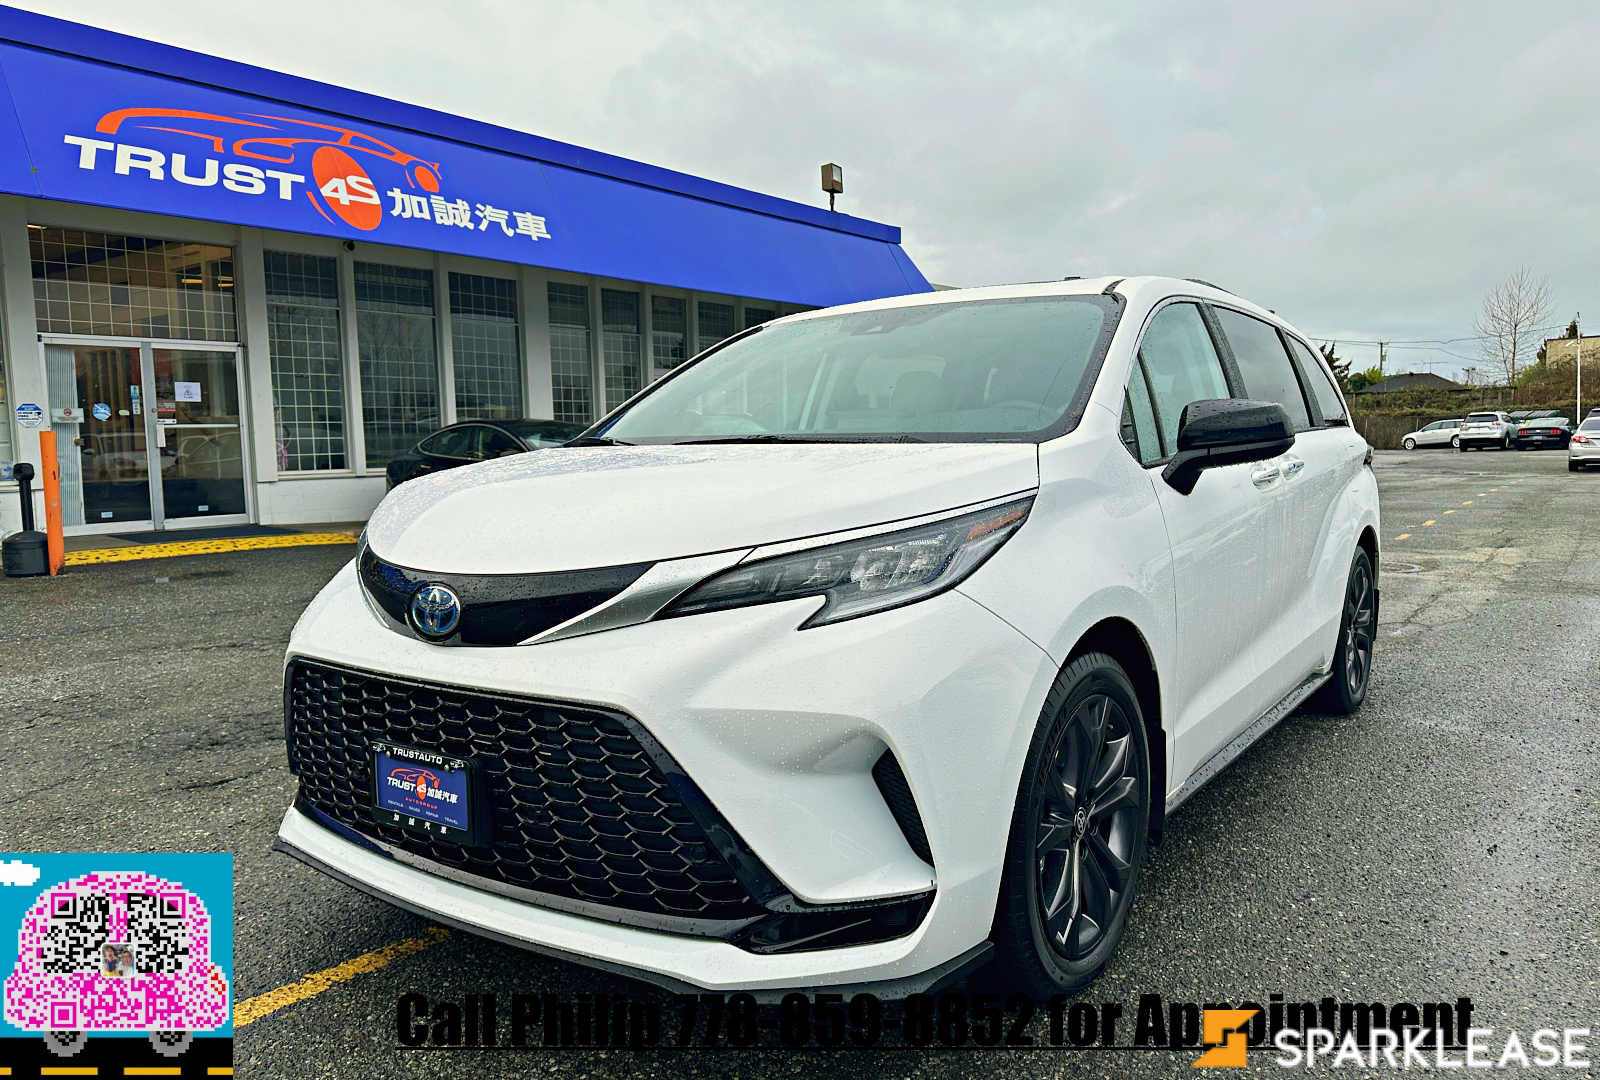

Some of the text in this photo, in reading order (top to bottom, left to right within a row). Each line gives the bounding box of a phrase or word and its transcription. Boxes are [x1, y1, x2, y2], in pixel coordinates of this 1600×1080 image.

[64, 134, 552, 241] TRUST 4S 加誠汽車
[392, 747, 443, 764] TRUSTAUTO
[387, 776, 416, 792] TRUST
